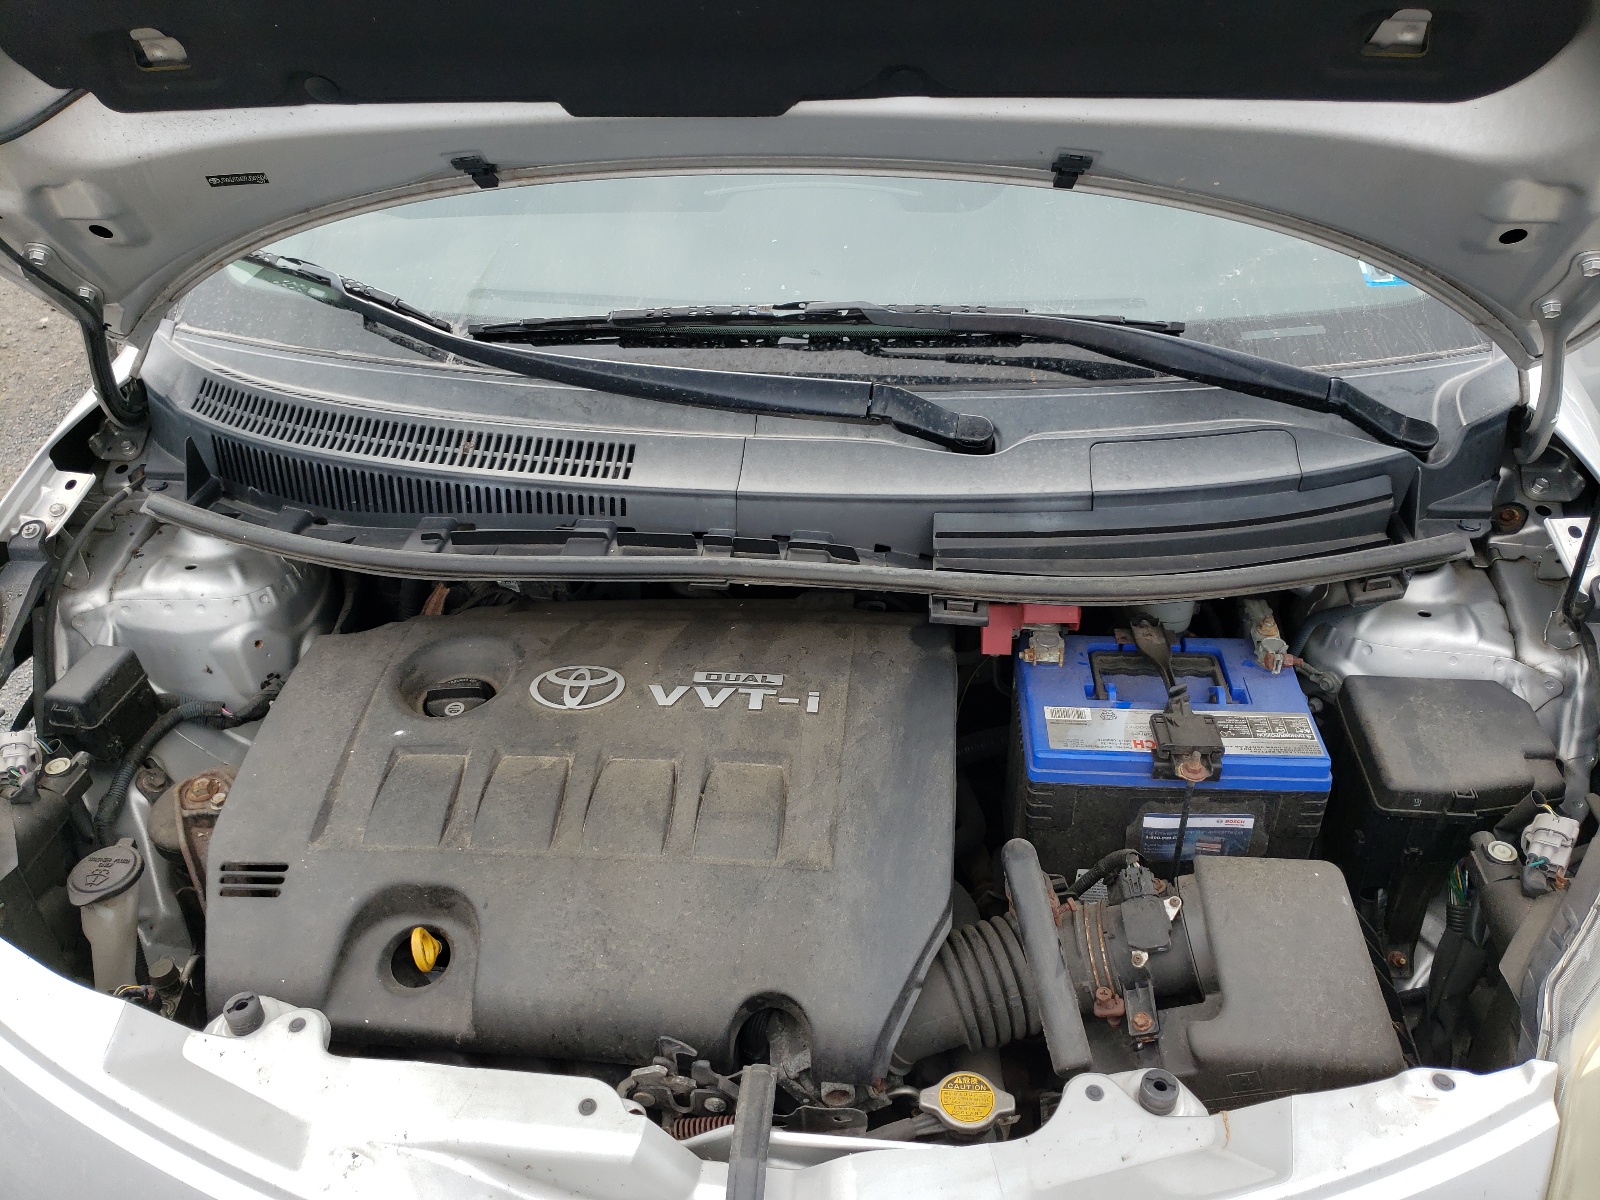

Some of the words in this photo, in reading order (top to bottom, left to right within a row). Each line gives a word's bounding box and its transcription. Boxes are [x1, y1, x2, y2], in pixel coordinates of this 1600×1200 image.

[704, 673, 777, 684] DUAL
[649, 685, 820, 713] VVT-i
[947, 1083, 987, 1091] CAUTION
